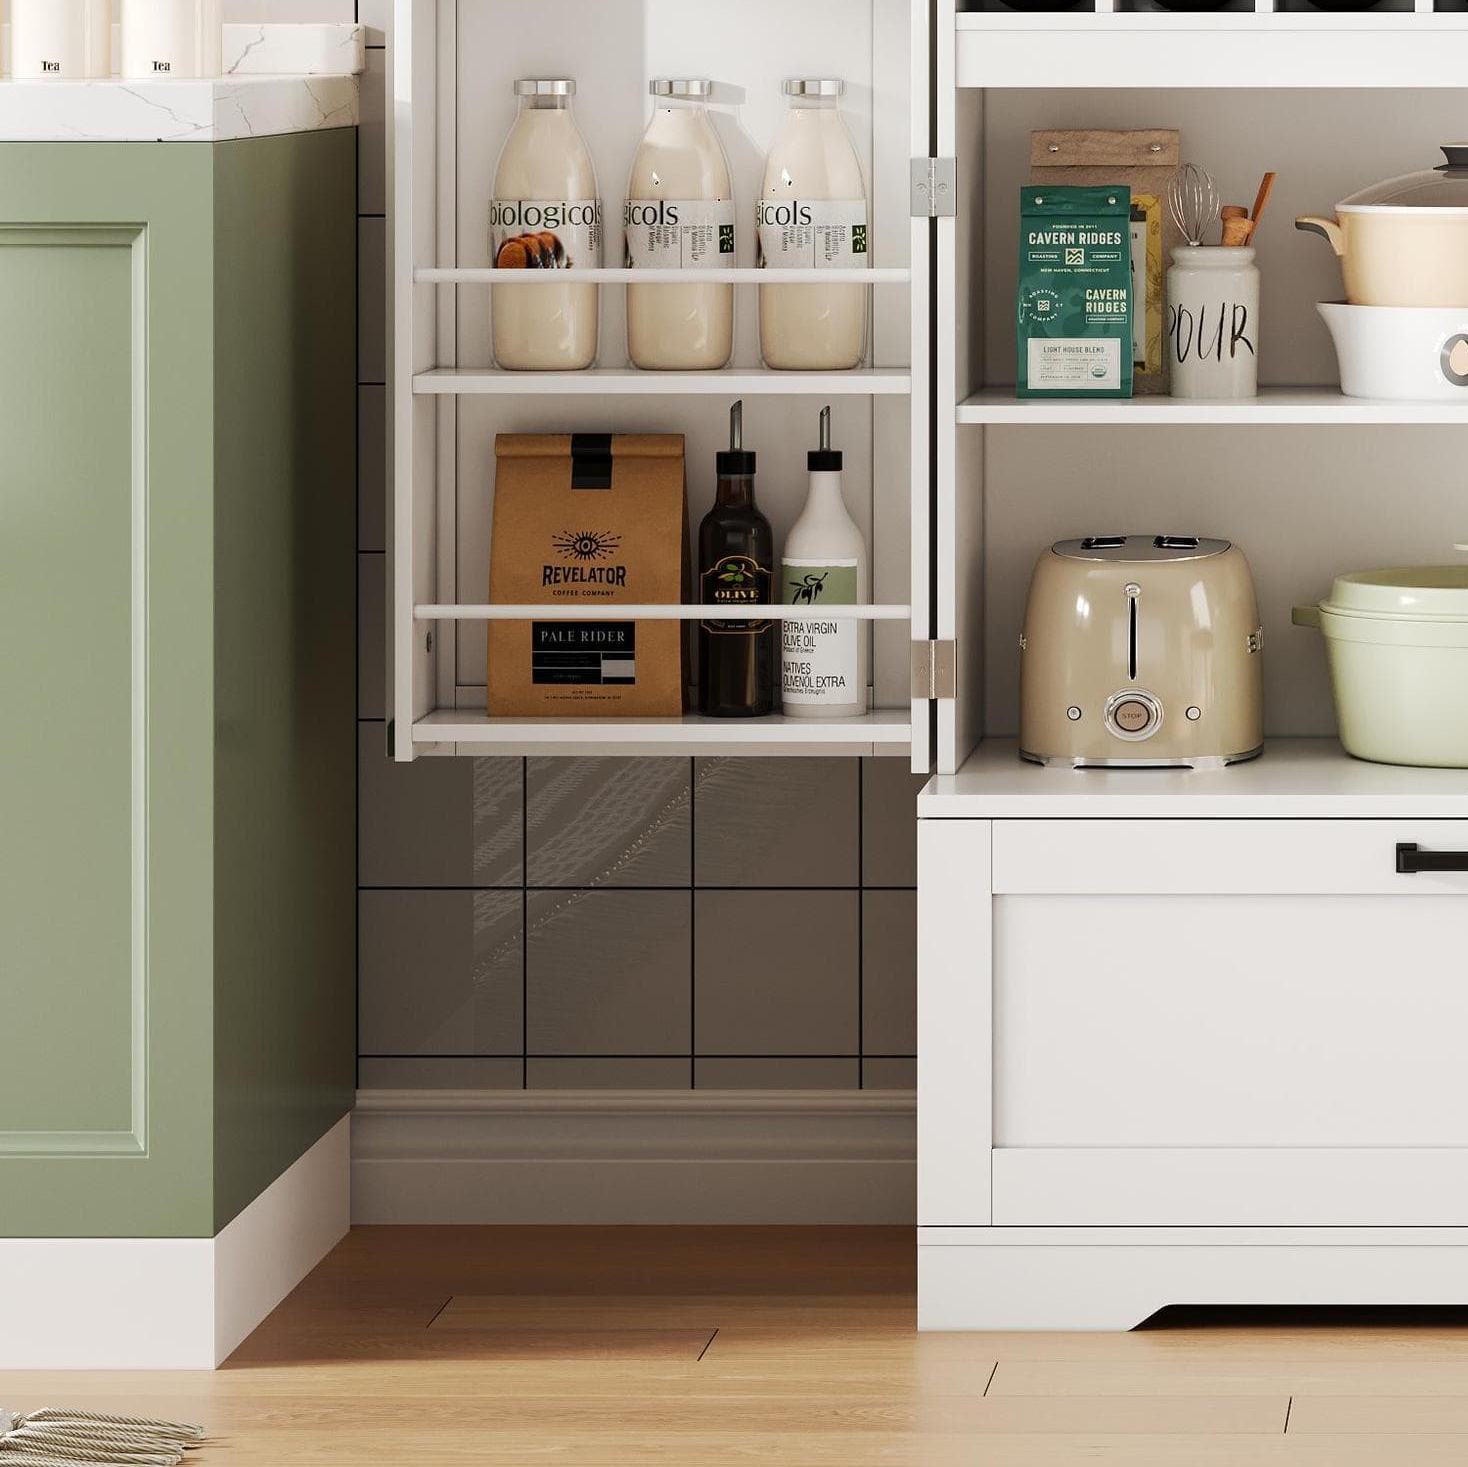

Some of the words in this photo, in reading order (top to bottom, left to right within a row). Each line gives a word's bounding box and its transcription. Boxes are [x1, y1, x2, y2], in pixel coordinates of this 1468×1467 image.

[41, 61, 60, 71] Tea
[152, 61, 171, 71] Tea
[1029, 232, 1075, 245] CAVERN
[1079, 232, 1121, 245] RIDGES
[1086, 289, 1127, 300] CAVERN
[1086, 302, 1127, 312] RIDGES
[542, 565, 626, 587] REVELATOR
[714, 590, 759, 598] OLIVE
[783, 621, 804, 633] EXTRA
[806, 622, 837, 634] VIRGIN
[541, 630, 576, 642] PALE
[581, 630, 625, 642] RIDER
[783, 634, 801, 647] OLIVE
[804, 635, 816, 647] OIL
[783, 661, 811, 675] NATIVES
[816, 675, 846, 688] EXTRA
